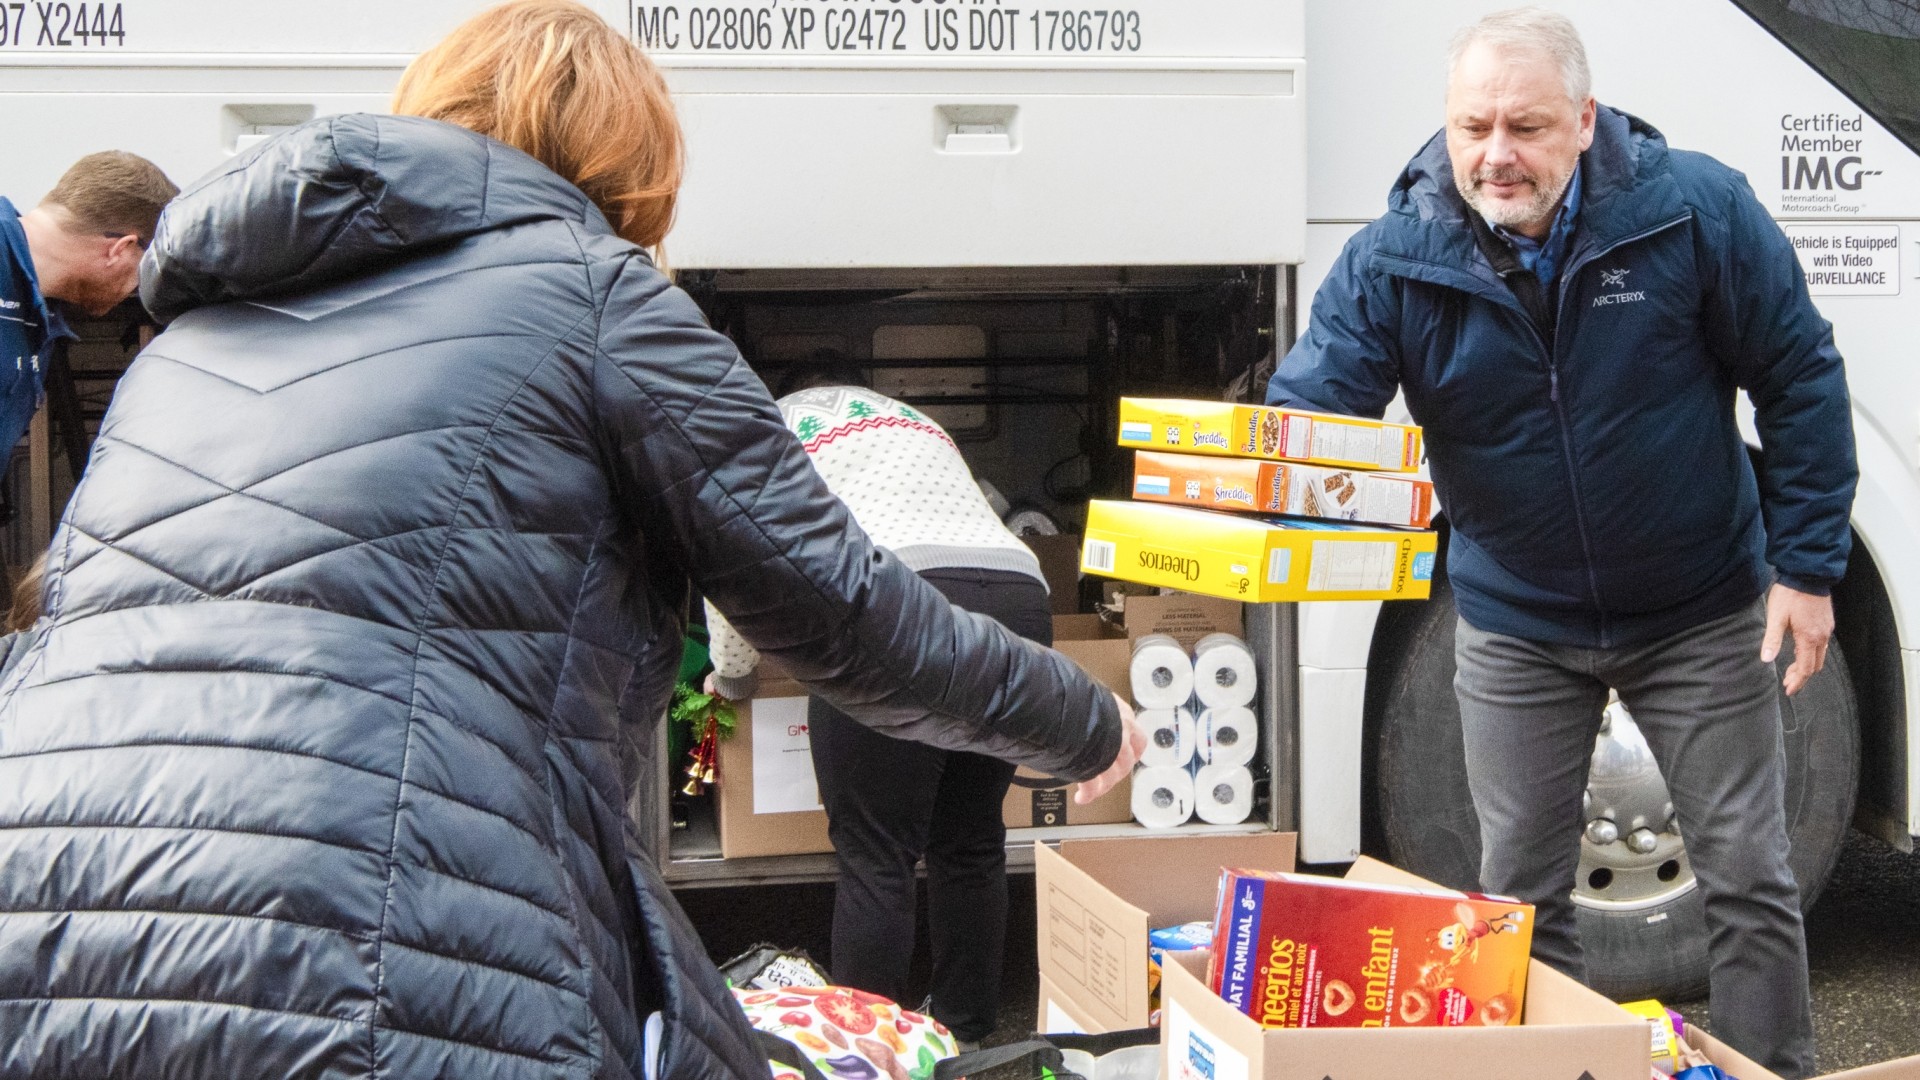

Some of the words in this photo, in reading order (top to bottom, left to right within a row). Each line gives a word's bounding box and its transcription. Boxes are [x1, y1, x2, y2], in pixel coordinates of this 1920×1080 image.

[36, 2, 125, 46] X2444
[638, 6, 679, 49] MC
[689, 7, 772, 50] 02806
[781, 7, 815, 50] XP
[924, 9, 958, 50] US
[969, 9, 1020, 50] DOT
[1030, 10, 1142, 51] 1786793
[1781, 113, 1862, 132] Certified
[1781, 135, 1862, 152] Member
[1782, 156, 1864, 191] IMG
[1782, 194, 1836, 203] International
[1782, 204, 1831, 212] Motorcoach
[1833, 204, 1860, 214] Group
[1788, 236, 1829, 249] Vehicle
[1832, 236, 1842, 249] is
[1845, 235, 1897, 252] Equipped
[1813, 254, 1838, 267] with
[1841, 254, 1873, 267] Video
[1193, 431, 1228, 449] Shreddies
[1247, 410, 1259, 453] Shreddies
[1215, 486, 1253, 505] Shreddies
[1271, 466, 1284, 511] Shreddies
[1139, 550, 1200, 581] Cheerios
[1396, 538, 1412, 593] Cheerios
[1232, 915, 1253, 981] FAMILIAL
[1296, 943, 1308, 965] noix
[1294, 967, 1304, 986] aux
[1361, 925, 1394, 1011] enfant
[1389, 947, 1399, 986] HEUREUX
[1292, 987, 1301, 998] et
[1288, 1000, 1300, 1021] miel
